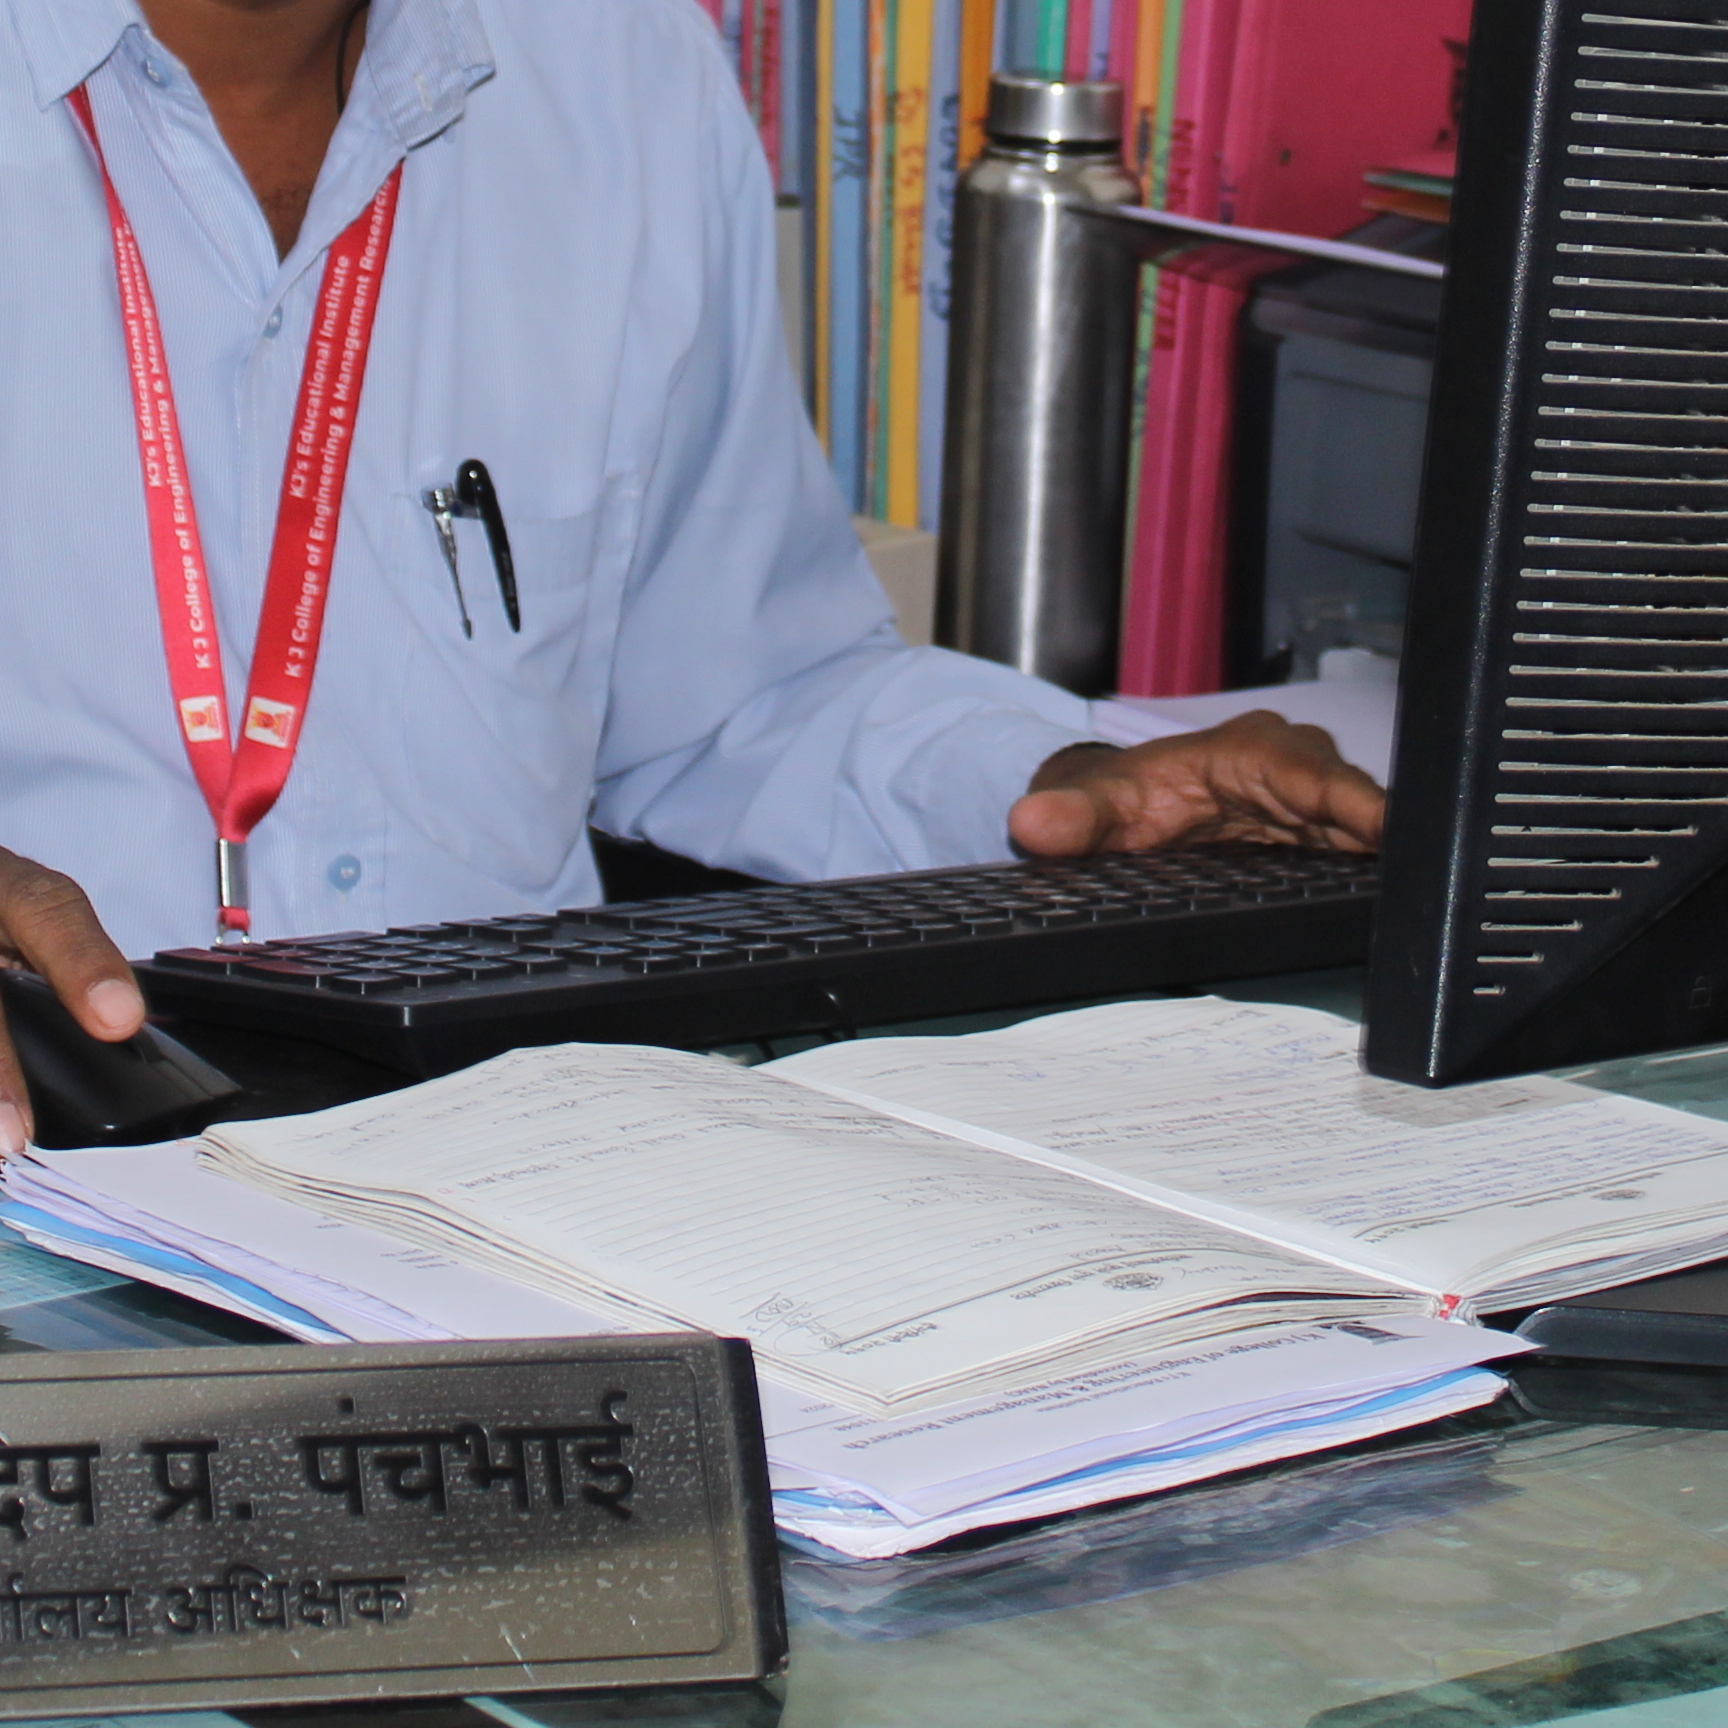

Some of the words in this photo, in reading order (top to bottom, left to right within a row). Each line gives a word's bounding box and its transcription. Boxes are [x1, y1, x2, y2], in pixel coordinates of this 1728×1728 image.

[115, 226, 139, 315] Institute
[126, 240, 161, 374] Management
[318, 255, 351, 338] Institute
[332, 274, 373, 402] Management
[130, 319, 154, 442] Educational
[152, 378, 165, 394] &
[294, 342, 333, 457] Educational
[330, 405, 345, 420] &
[145, 452, 162, 488] KJ's
[154, 397, 188, 525] Engineering
[289, 459, 309, 499] KJ's
[309, 424, 348, 541] Engineering
[176, 527, 191, 551] of
[306, 544, 323, 566] of
[179, 554, 206, 633] College
[292, 570, 320, 643] College
[193, 637, 209, 650] J
[195, 652, 212, 670] K
[286, 645, 304, 659] J
[284, 660, 303, 678] K
[1202, 1351, 1225, 1362] of
[1224, 1337, 1297, 1355] College
[1066, 1385, 1090, 1394] &
[1081, 1356, 1207, 1388] Engineering
[935, 1392, 1072, 1426] Management
[840, 1422, 945, 1451] Research
[142, 1440, 255, 1521] प्र.
[297, 1390, 635, 1521] पंचभाई
[167, 1563, 410, 1634] अधिक्षक
